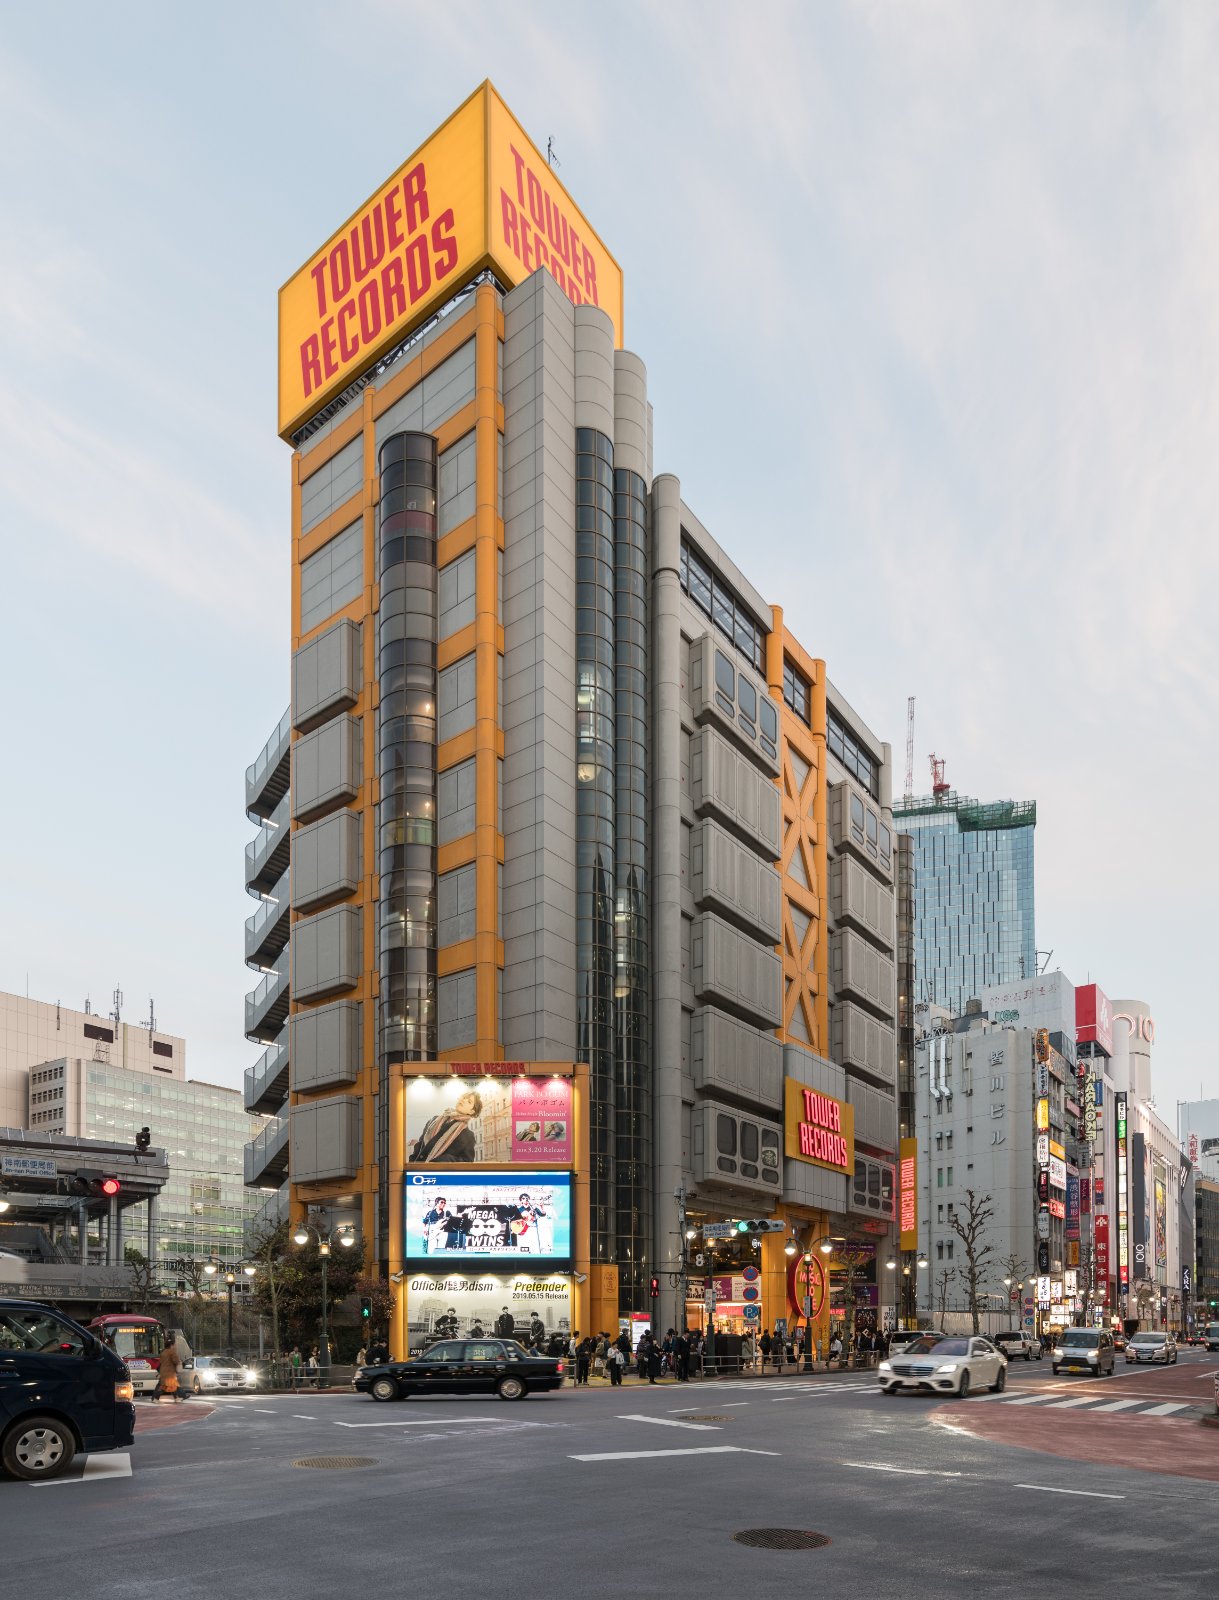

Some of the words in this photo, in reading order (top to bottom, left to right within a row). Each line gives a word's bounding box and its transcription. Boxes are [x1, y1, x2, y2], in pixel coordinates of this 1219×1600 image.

[311, 162, 430, 319] TOWER
[510, 142, 598, 305] TOWER
[300, 208, 458, 398] RECORDS
[451, 1063, 482, 1074] TOWER
[484, 1063, 526, 1074] RECORDS
[802, 1089, 841, 1133] TOWER
[799, 1121, 848, 1167] RECORDS
[901, 1156, 915, 1188] TOWER
[901, 1190, 915, 1232] RECORDS
[465, 1235, 504, 1247] TWINS
[514, 1281, 567, 1292] Pretender
